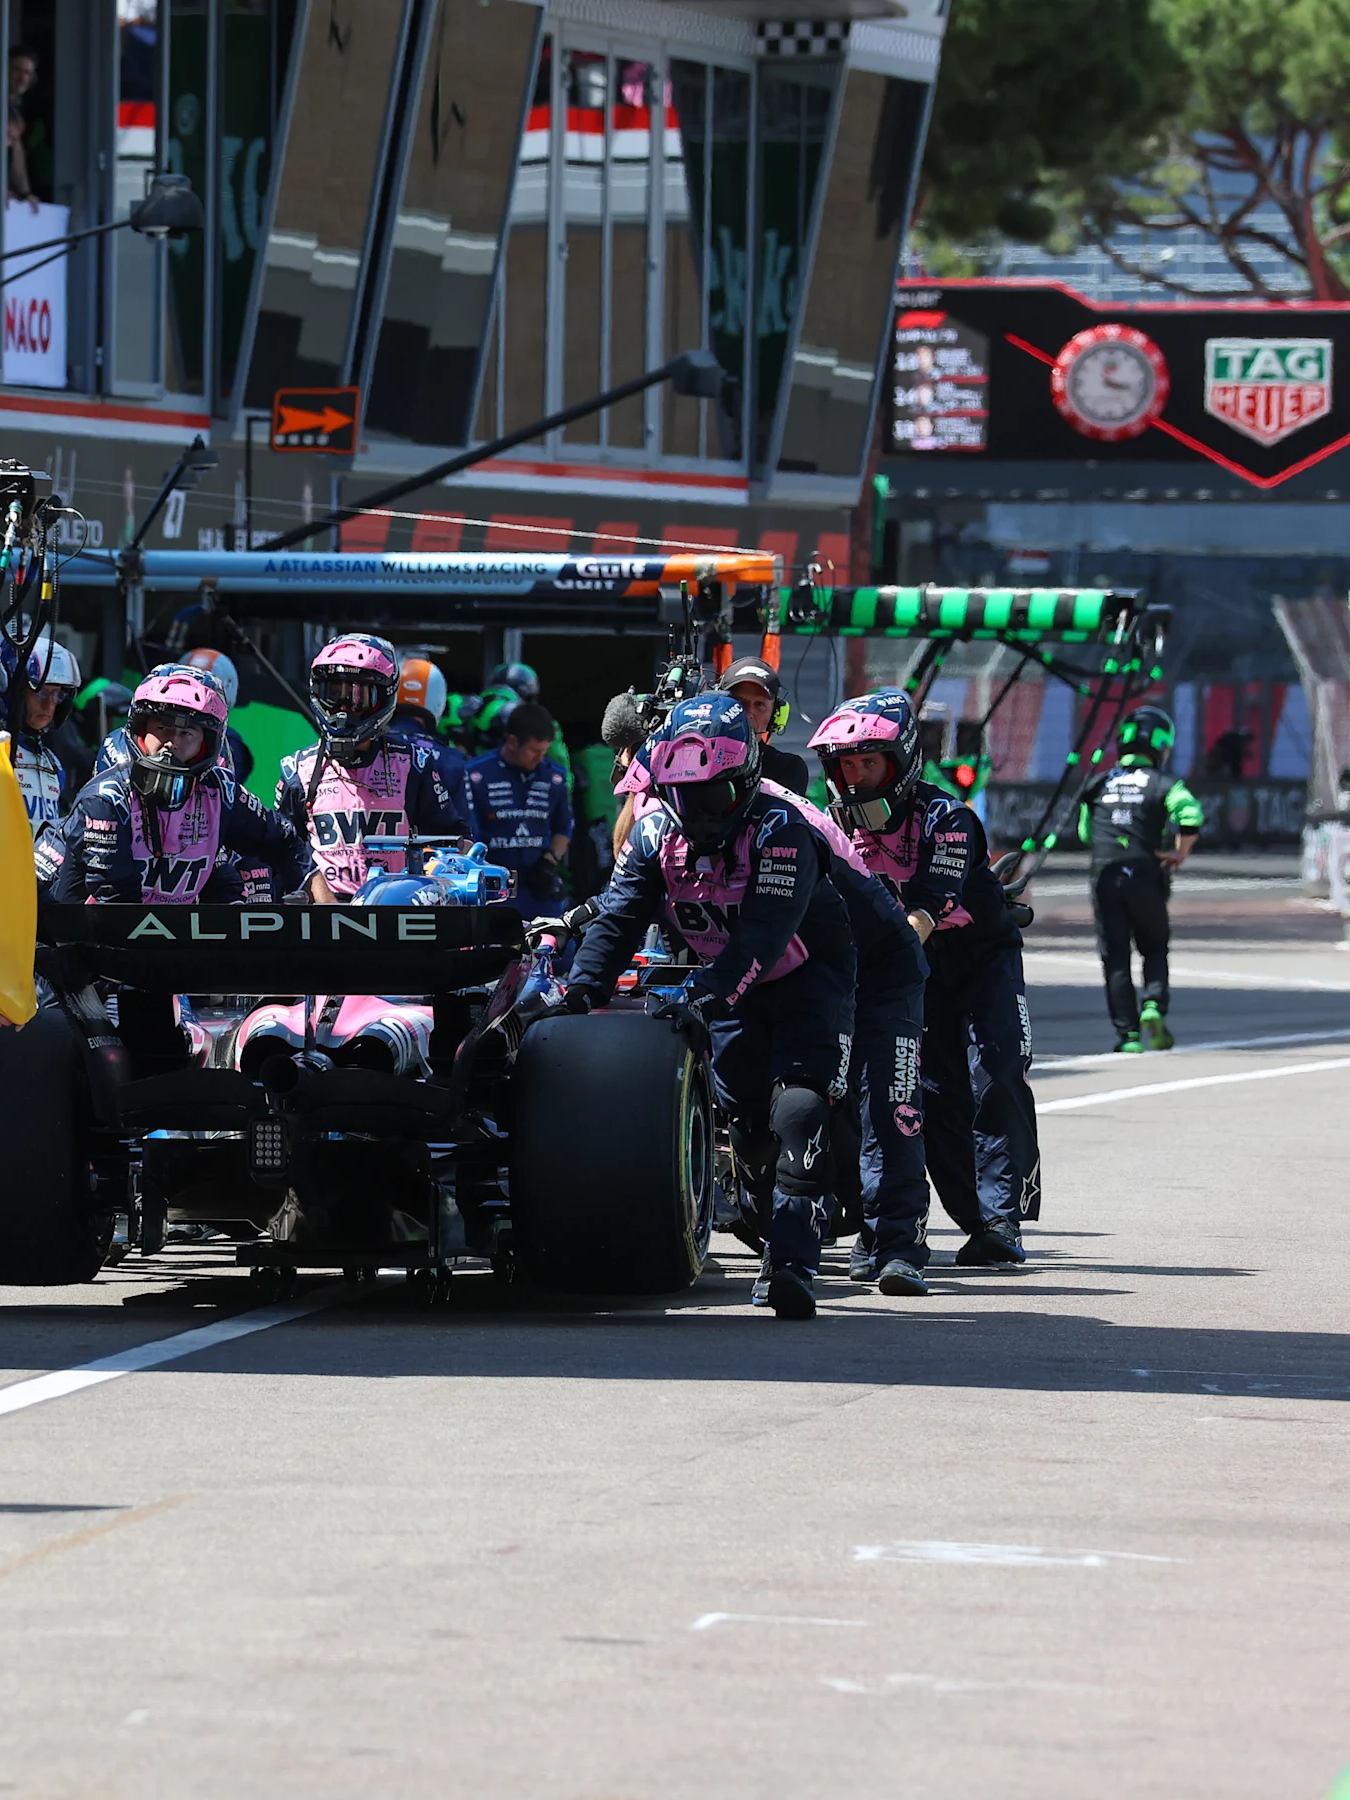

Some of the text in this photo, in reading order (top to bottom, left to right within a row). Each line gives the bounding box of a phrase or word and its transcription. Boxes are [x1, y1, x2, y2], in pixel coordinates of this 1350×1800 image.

[1219, 348, 1325, 379] TAG
[1211, 384, 1327, 434] HEUER
[281, 560, 548, 575] ATLASSIAN WILLIAMS RACING
[576, 557, 646, 578] Gulf
[725, 703, 743, 720] MSC
[318, 786, 340, 797] MSC
[93, 818, 118, 831] BWT
[311, 810, 405, 846] BWT
[945, 832, 968, 842] BWT
[772, 847, 797, 858] BWT
[773, 864, 797, 872] mntn
[932, 855, 966, 868] PIRELLI
[324, 861, 360, 882] eni
[929, 865, 963, 879] INFINOX
[758, 874, 795, 886] PIRELLI
[756, 886, 793, 897] INFINOX
[127, 911, 437, 941] ALPINE
[736, 957, 763, 995] BWT
[895, 1036, 908, 1103] CHANGE
[907, 1038, 917, 1090] WORLD
